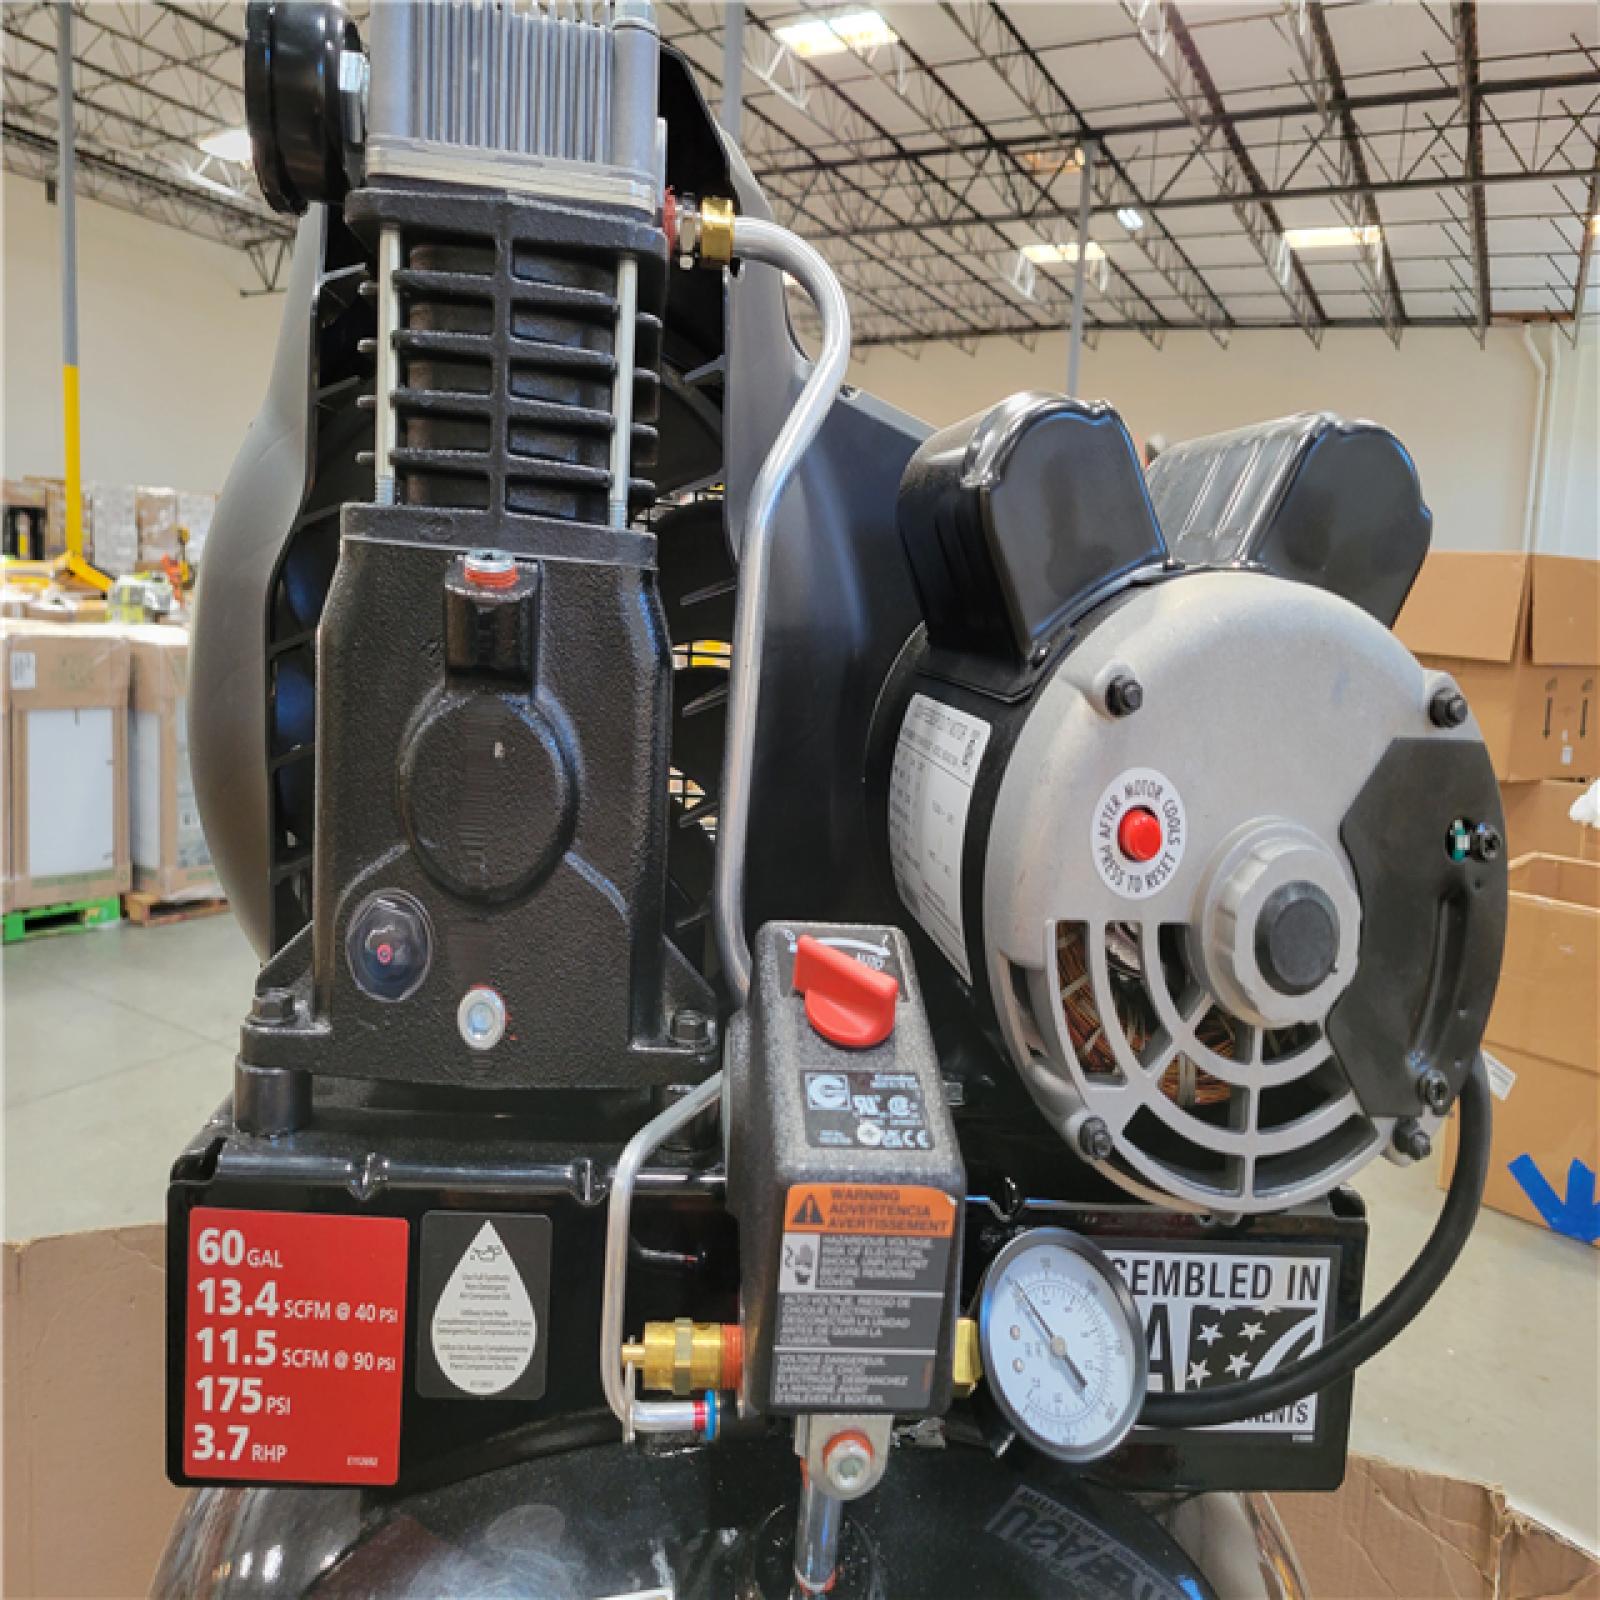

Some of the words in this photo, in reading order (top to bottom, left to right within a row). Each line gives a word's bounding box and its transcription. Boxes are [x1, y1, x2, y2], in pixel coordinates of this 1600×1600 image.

[1099, 795, 1121, 840] AFTER
[1124, 779, 1163, 800] MOTOR
[1162, 799, 1181, 845] COOLS
[1100, 844, 1126, 886] PRESS
[1127, 874, 1142, 893] TO
[1144, 851, 1176, 890] RESET
[829, 1203, 931, 1217] ADVERTENCIA
[830, 1188, 900, 1201] WARNING
[828, 1217, 949, 1232] AVERTISSEMENT
[197, 1227, 245, 1266] 60
[247, 1247, 284, 1268] GAL
[196, 1278, 279, 1316] 13.4
[284, 1299, 331, 1321] SCFM
[335, 1302, 351, 1321] @
[354, 1303, 376, 1322] 40
[379, 1307, 397, 1323] PSI
[1287, 1264, 1321, 1301] IN
[195, 1327, 277, 1365] 11.5
[281, 1349, 328, 1371] SCFM
[334, 1350, 350, 1370] @
[352, 1351, 373, 1371] 90
[377, 1355, 396, 1372] PSI
[194, 1376, 264, 1414] 175
[266, 1397, 291, 1415] PSI
[1252, 1402, 1309, 1426] ENTS
[192, 1423, 250, 1461] 3.7
[252, 1444, 288, 1463] RHP
